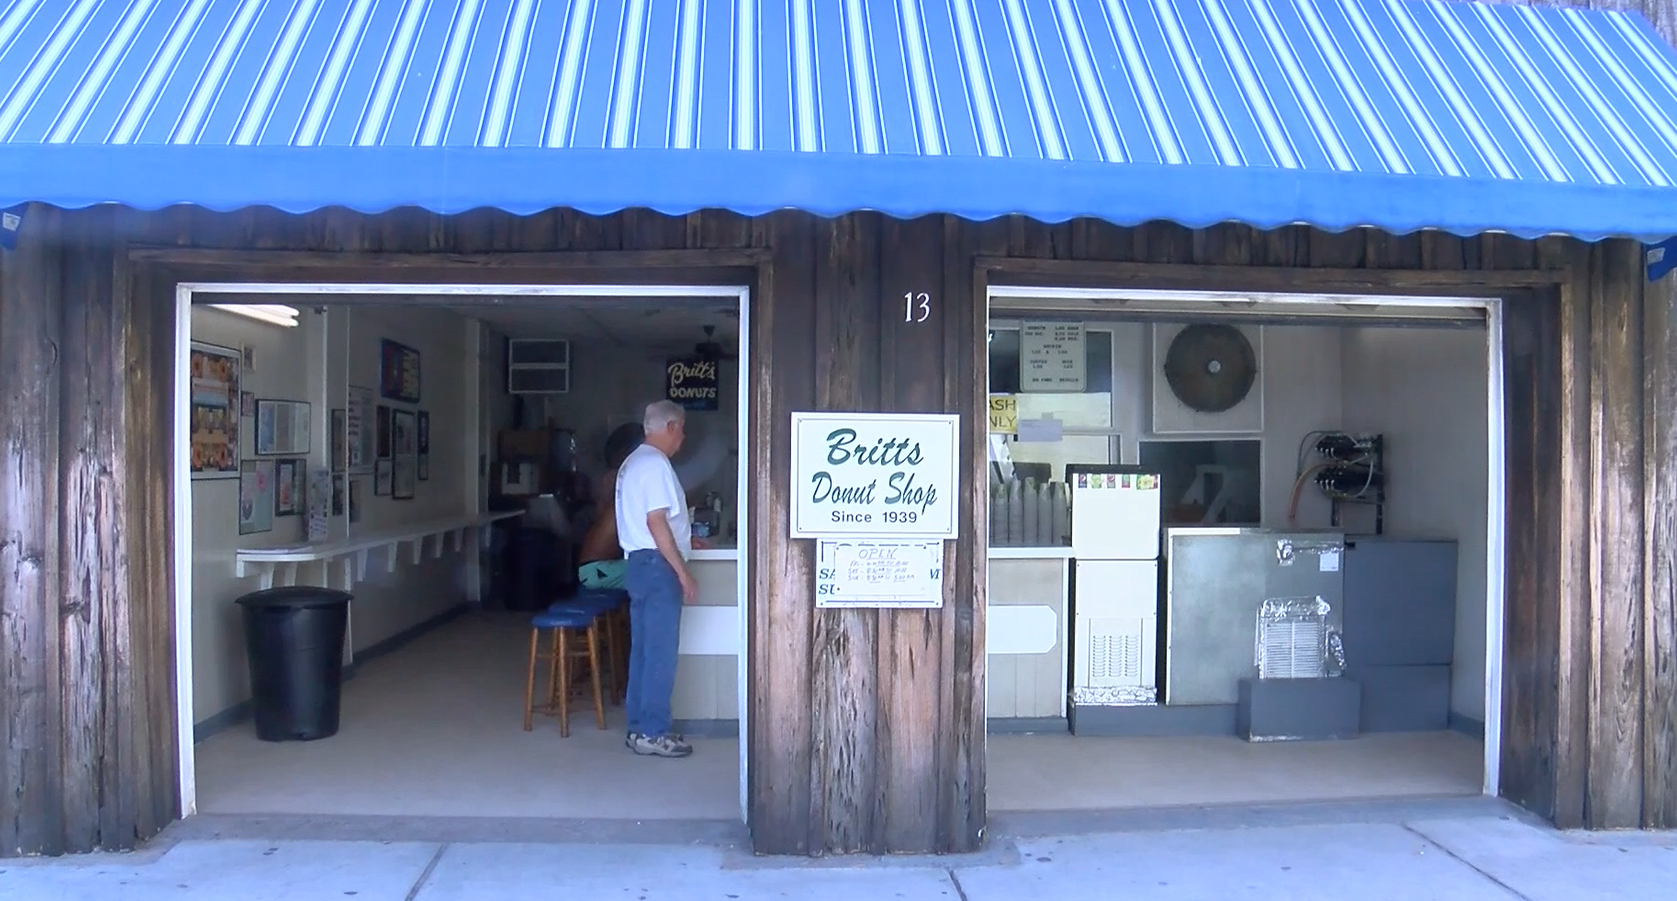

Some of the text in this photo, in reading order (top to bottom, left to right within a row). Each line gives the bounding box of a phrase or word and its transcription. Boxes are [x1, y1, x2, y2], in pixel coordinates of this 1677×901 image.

[904, 291, 930, 323] 13
[669, 361, 716, 387] Britt's
[670, 388, 717, 398] DONUTS
[989, 399, 1016, 411] ASH
[989, 415, 1017, 428] NLY
[826, 427, 924, 466] Britts
[811, 471, 938, 516] Donut Shop
[831, 510, 918, 524] Since 1939
[858, 547, 899, 560] OPEN
